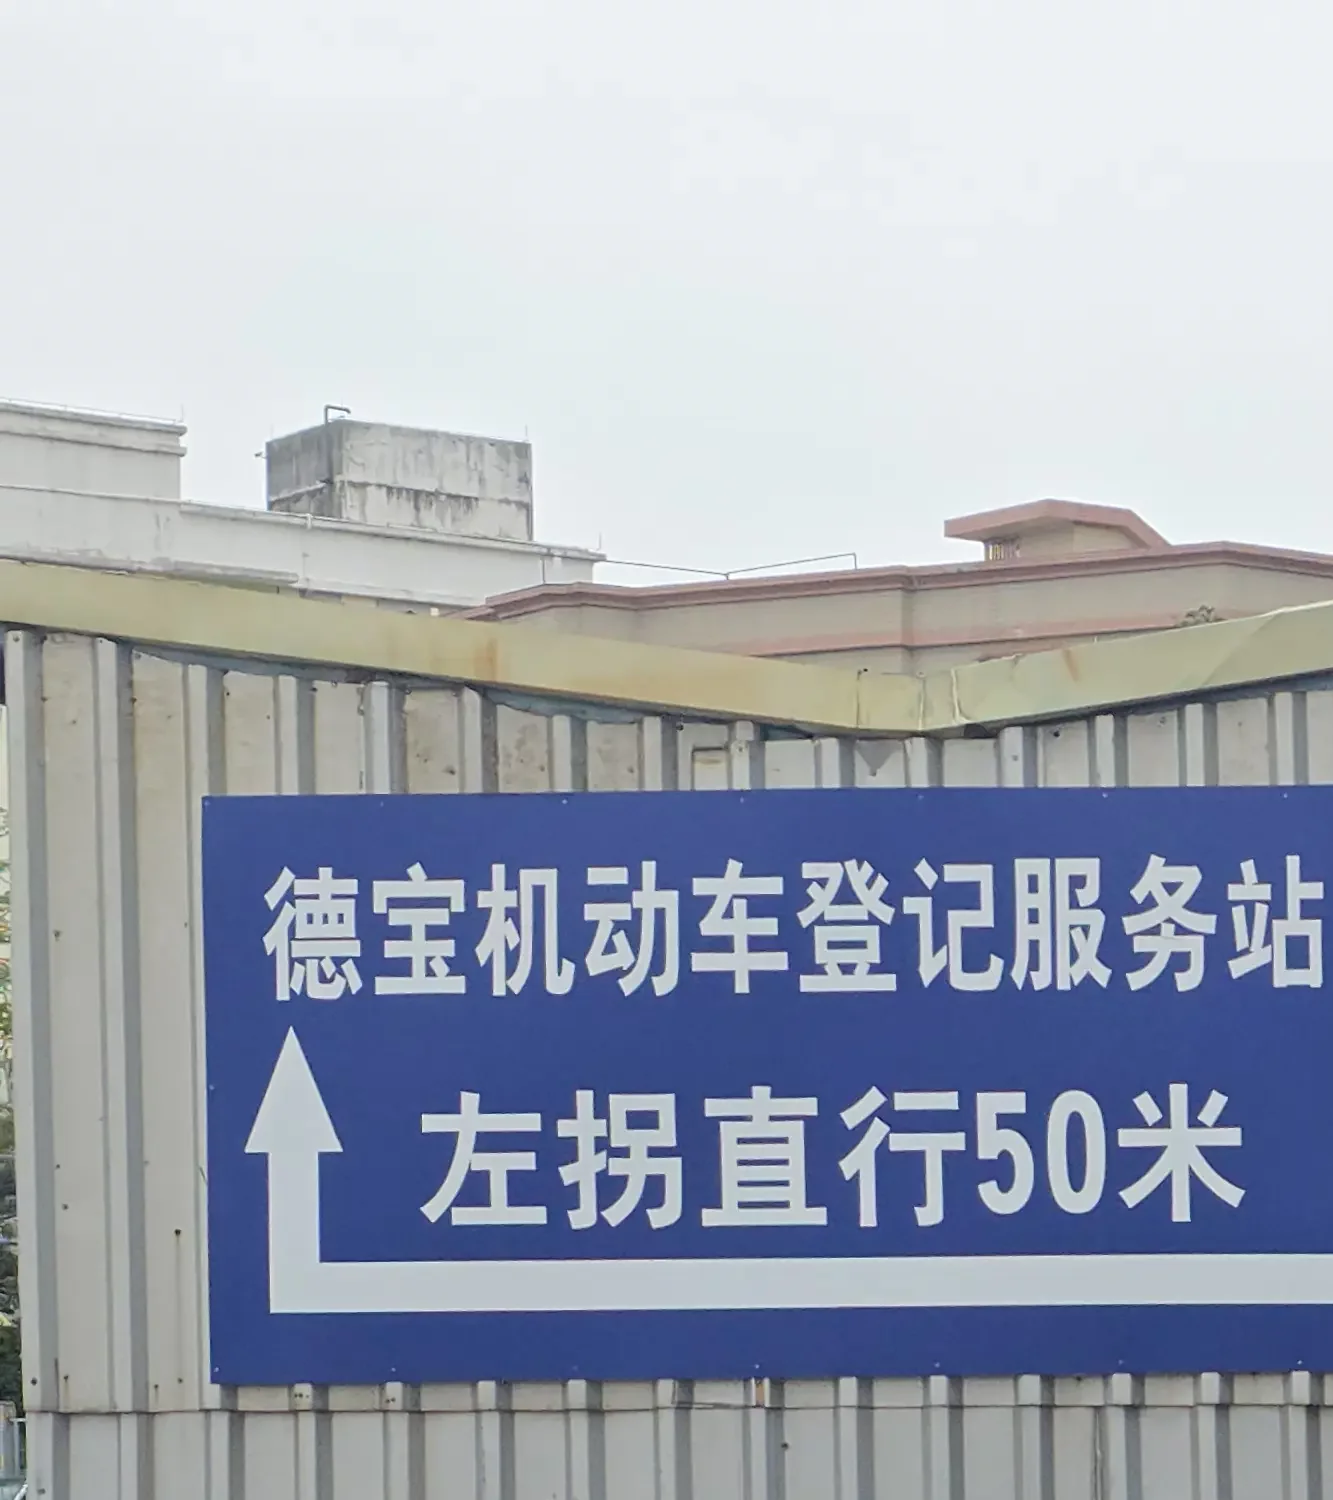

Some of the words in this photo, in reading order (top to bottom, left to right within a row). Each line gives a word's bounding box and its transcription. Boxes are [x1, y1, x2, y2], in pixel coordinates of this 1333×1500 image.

[264, 856, 1325, 1001] 德宝机动车登记服务站
[420, 1084, 1246, 1231] 左拐直行50米
